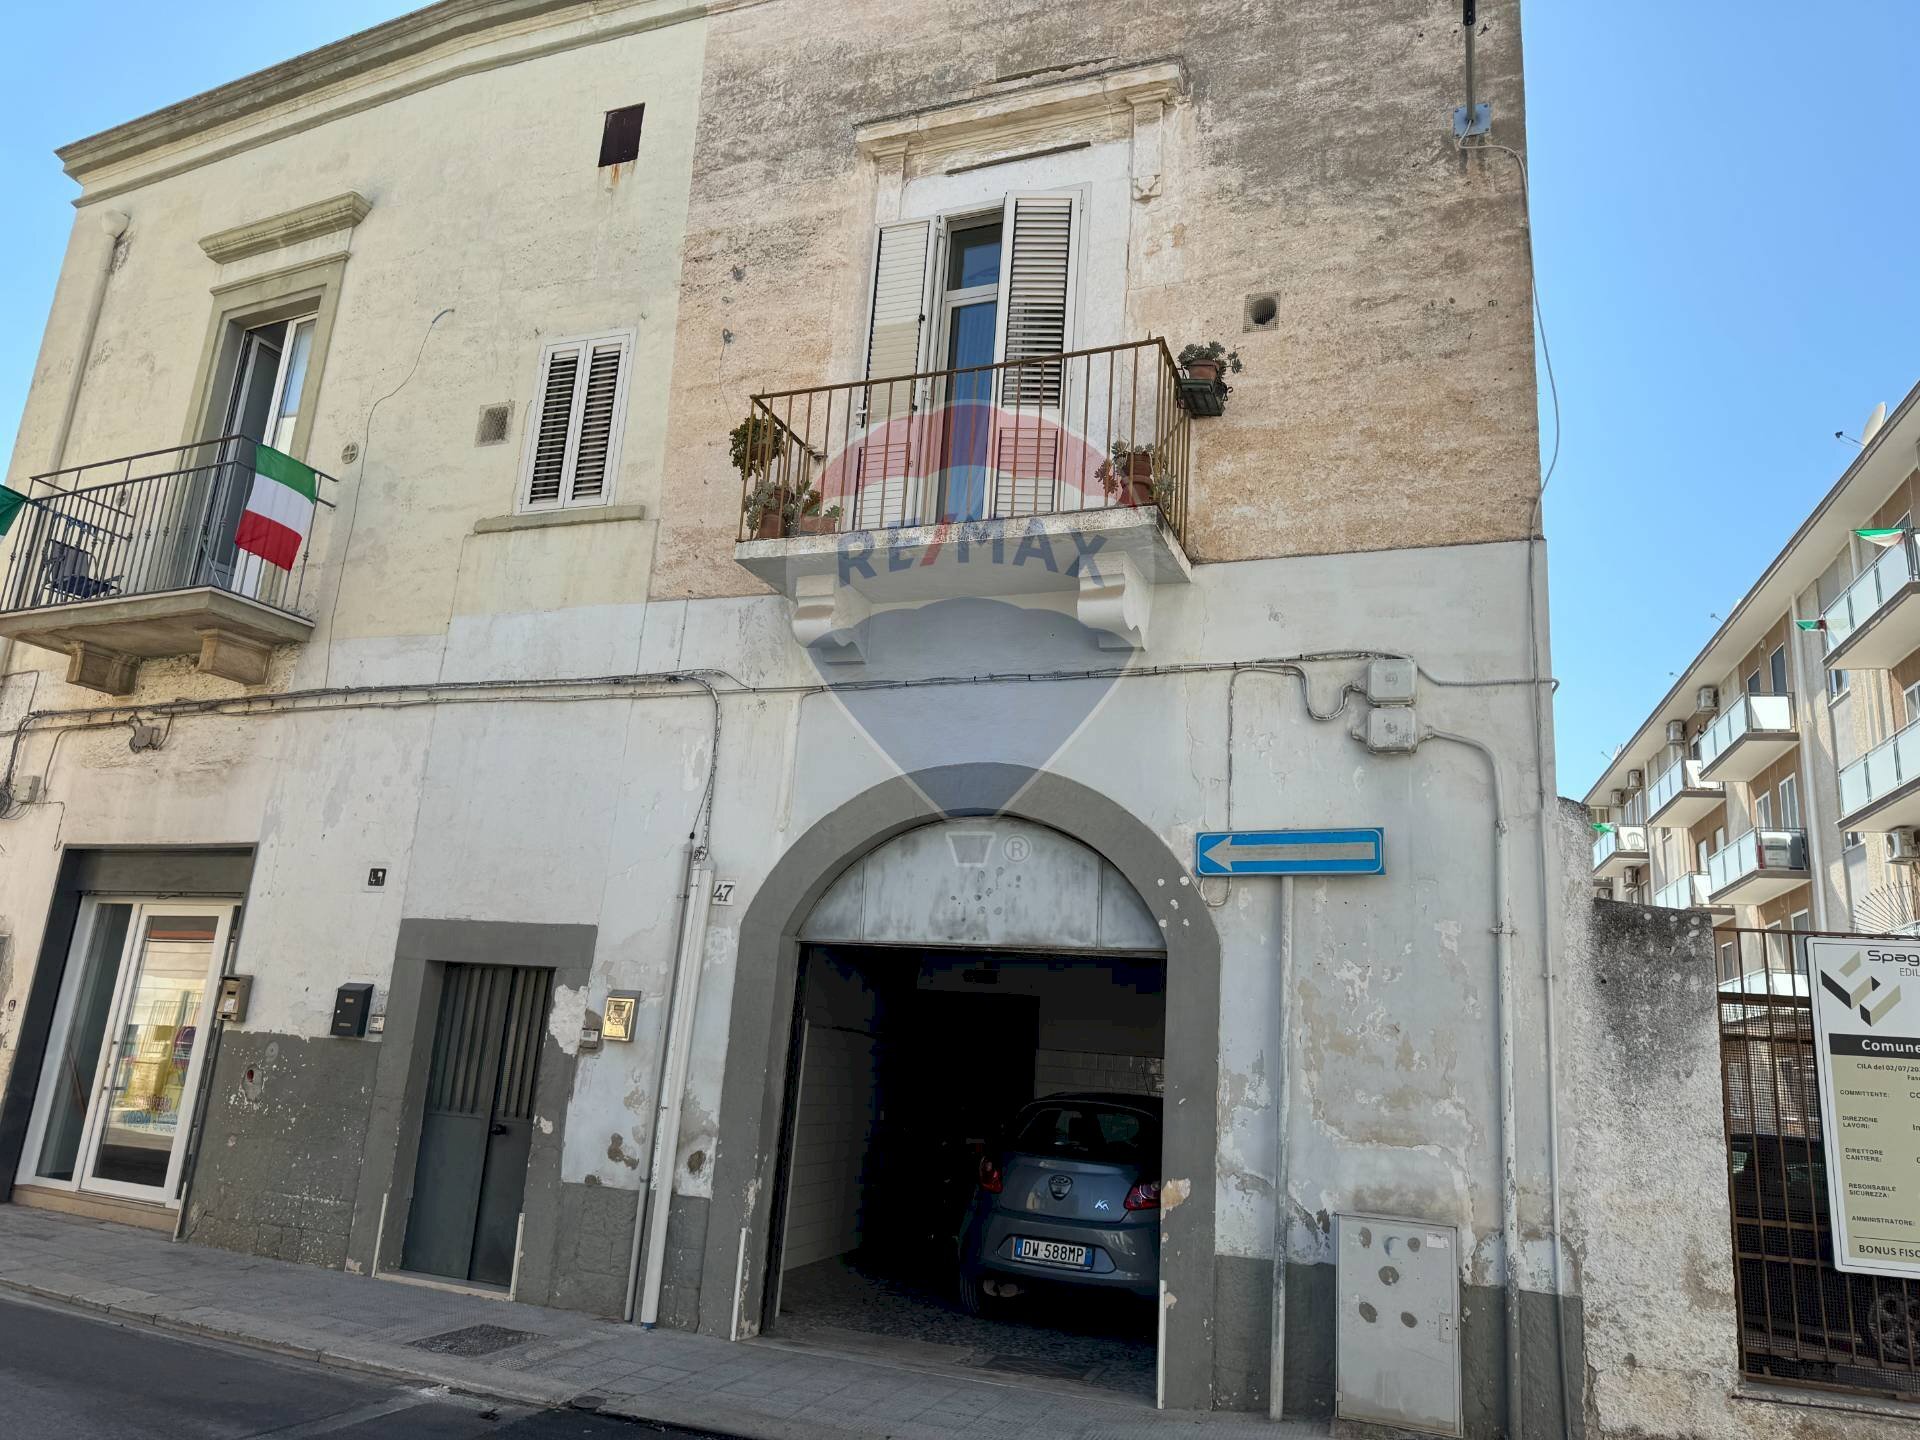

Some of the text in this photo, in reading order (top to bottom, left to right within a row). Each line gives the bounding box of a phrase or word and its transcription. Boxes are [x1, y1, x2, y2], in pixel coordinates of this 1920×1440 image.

[713, 884, 734, 901] 47
[1867, 949, 1920, 967] Spag
[1899, 967, 1920, 977] EDIL
[1861, 1039, 1920, 1054] Comune
[1842, 1115, 1878, 1123] DIREZIONE
[1845, 1147, 1884, 1156] DIRETTORE
[1023, 1241, 1084, 1263] DW 588MP
[1858, 1244, 1897, 1256] BONUS
